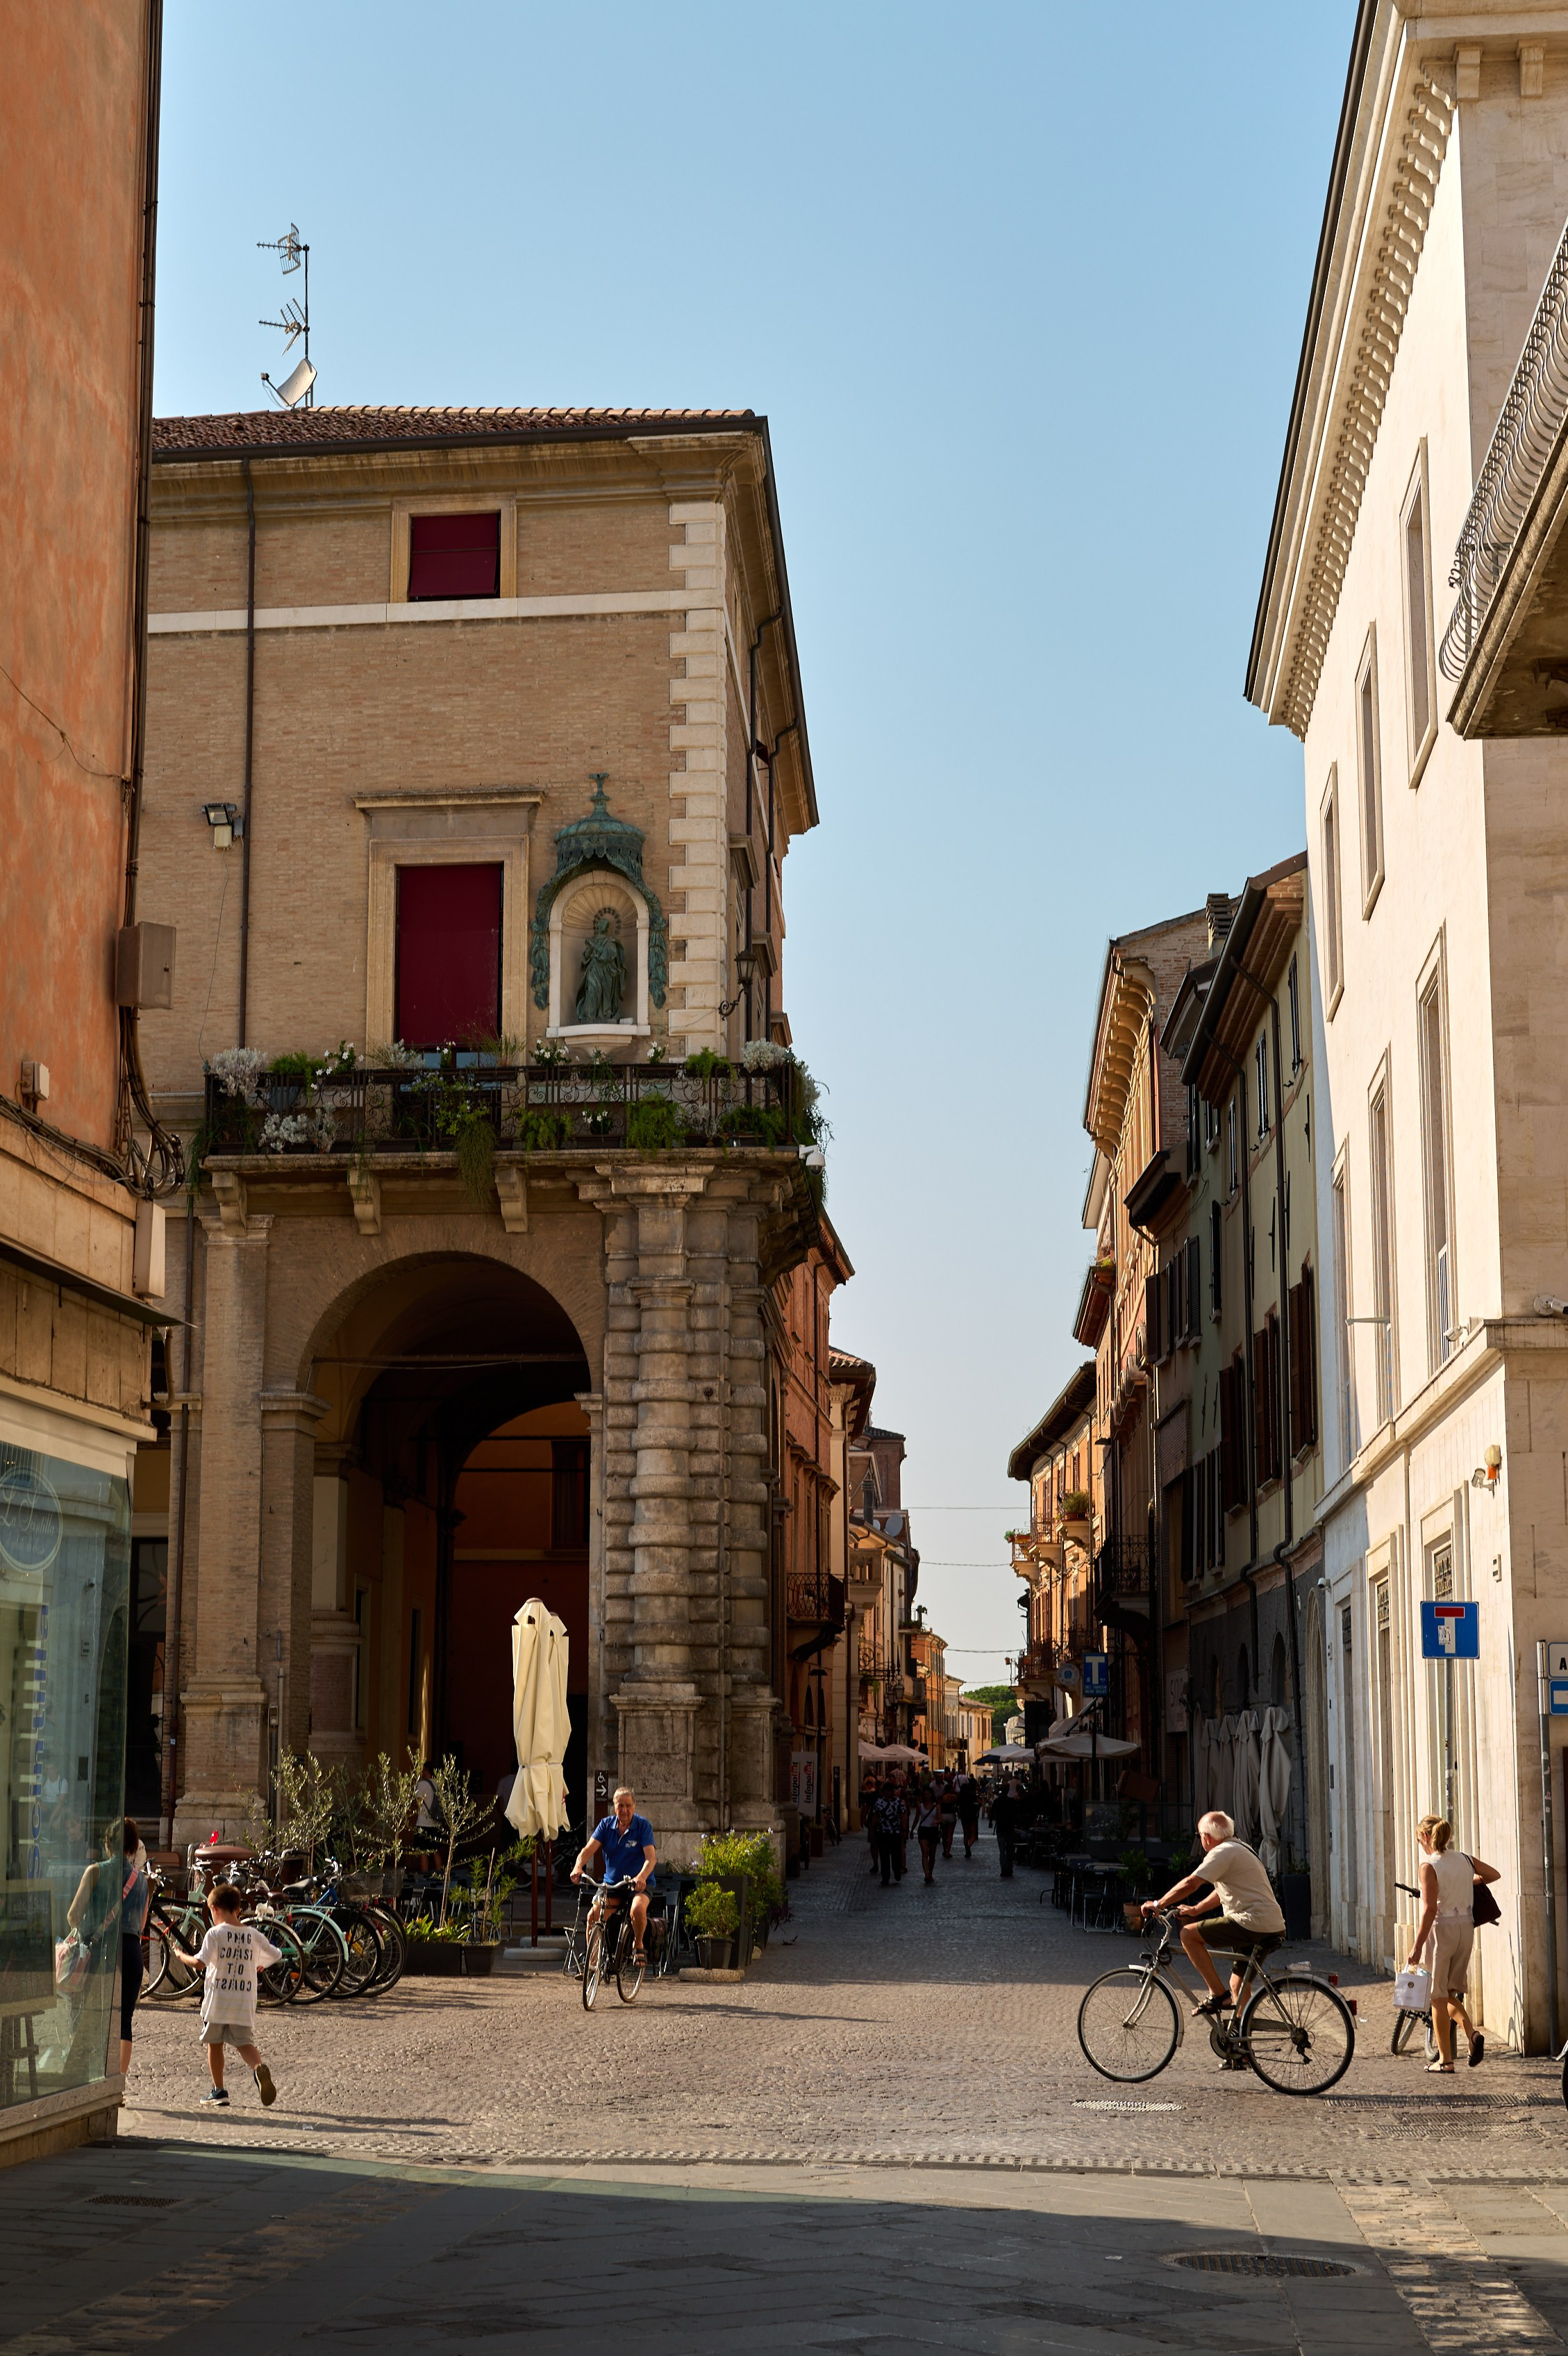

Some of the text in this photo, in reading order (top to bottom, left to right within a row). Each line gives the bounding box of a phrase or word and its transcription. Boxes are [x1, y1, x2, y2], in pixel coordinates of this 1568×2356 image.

[1085, 1656, 1106, 1684] T
[27, 1604, 49, 1880] Scintilla
[804, 1761, 812, 1804] infopoint
[219, 1947, 253, 1961] COAST
[227, 1963, 244, 1975] TO
